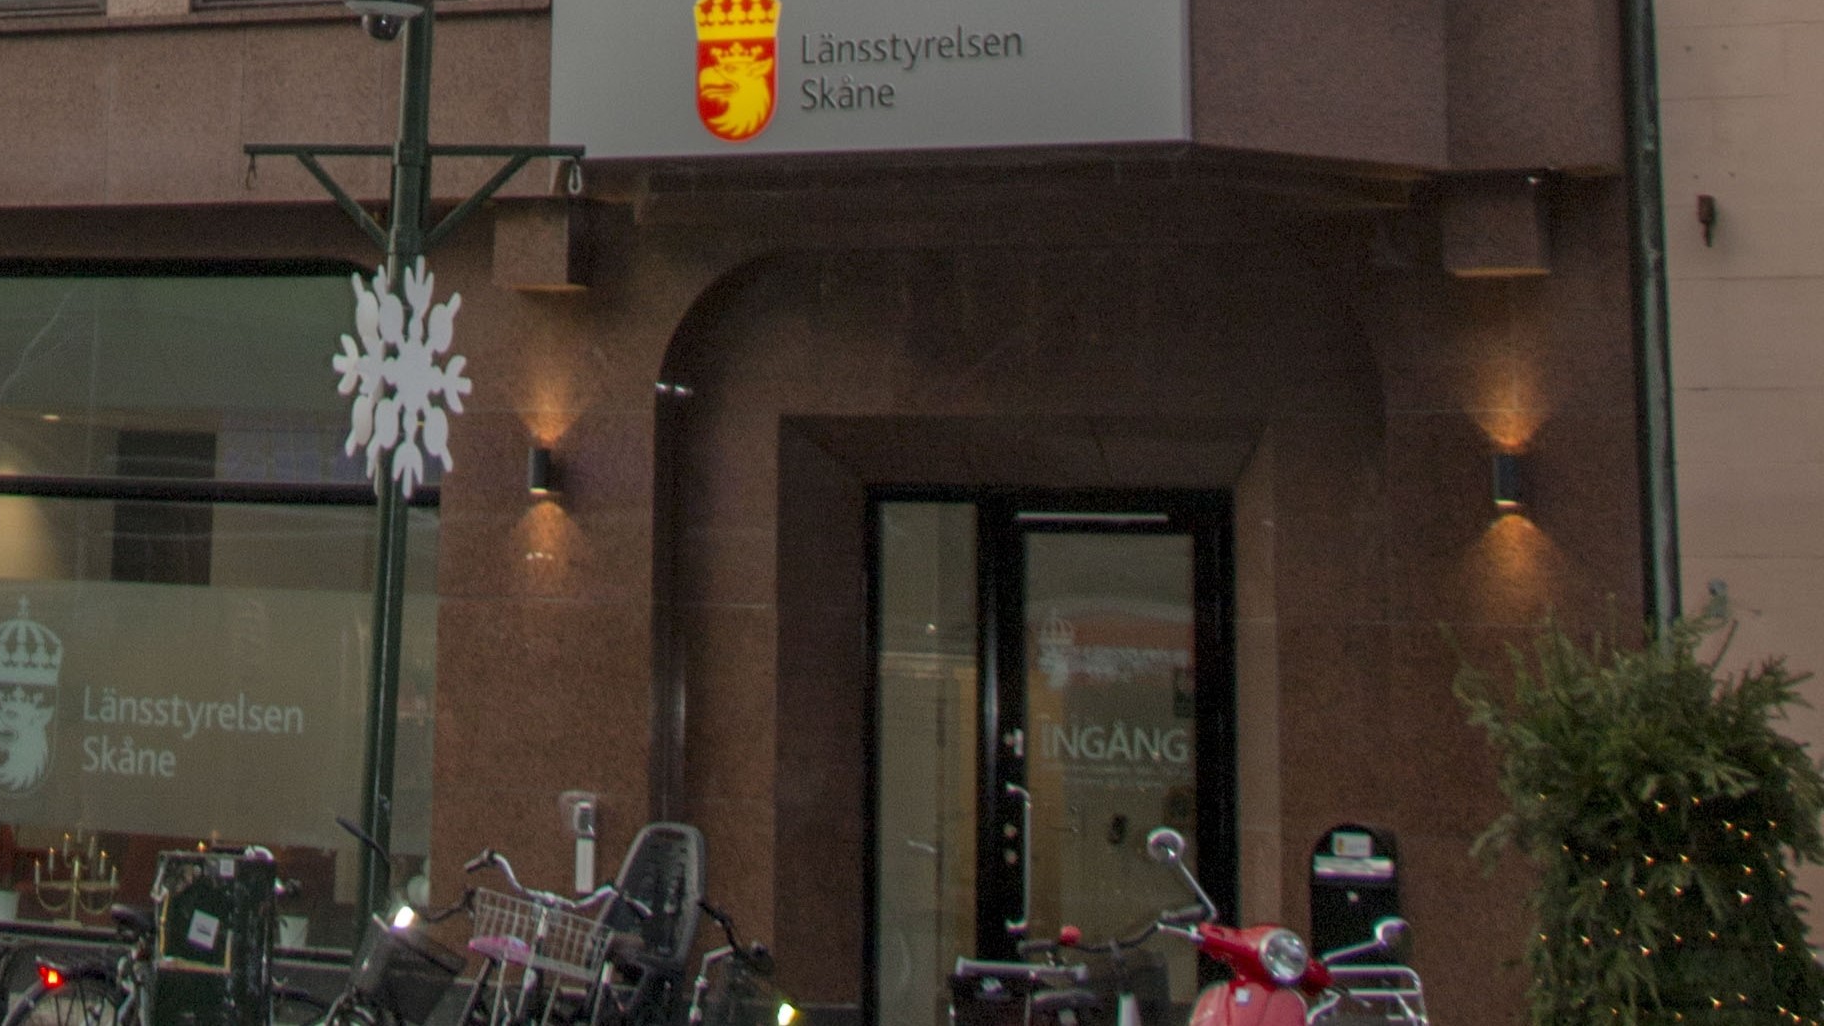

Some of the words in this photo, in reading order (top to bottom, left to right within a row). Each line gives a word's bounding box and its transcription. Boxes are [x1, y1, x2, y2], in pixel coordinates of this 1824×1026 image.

[801, 25, 1023, 71] Länsstyrelsen
[801, 75, 895, 110] Skåne
[83, 685, 304, 740] Länsstyrelsen
[83, 735, 176, 777] Skåne
[1040, 718, 1189, 763] INGÅNG
